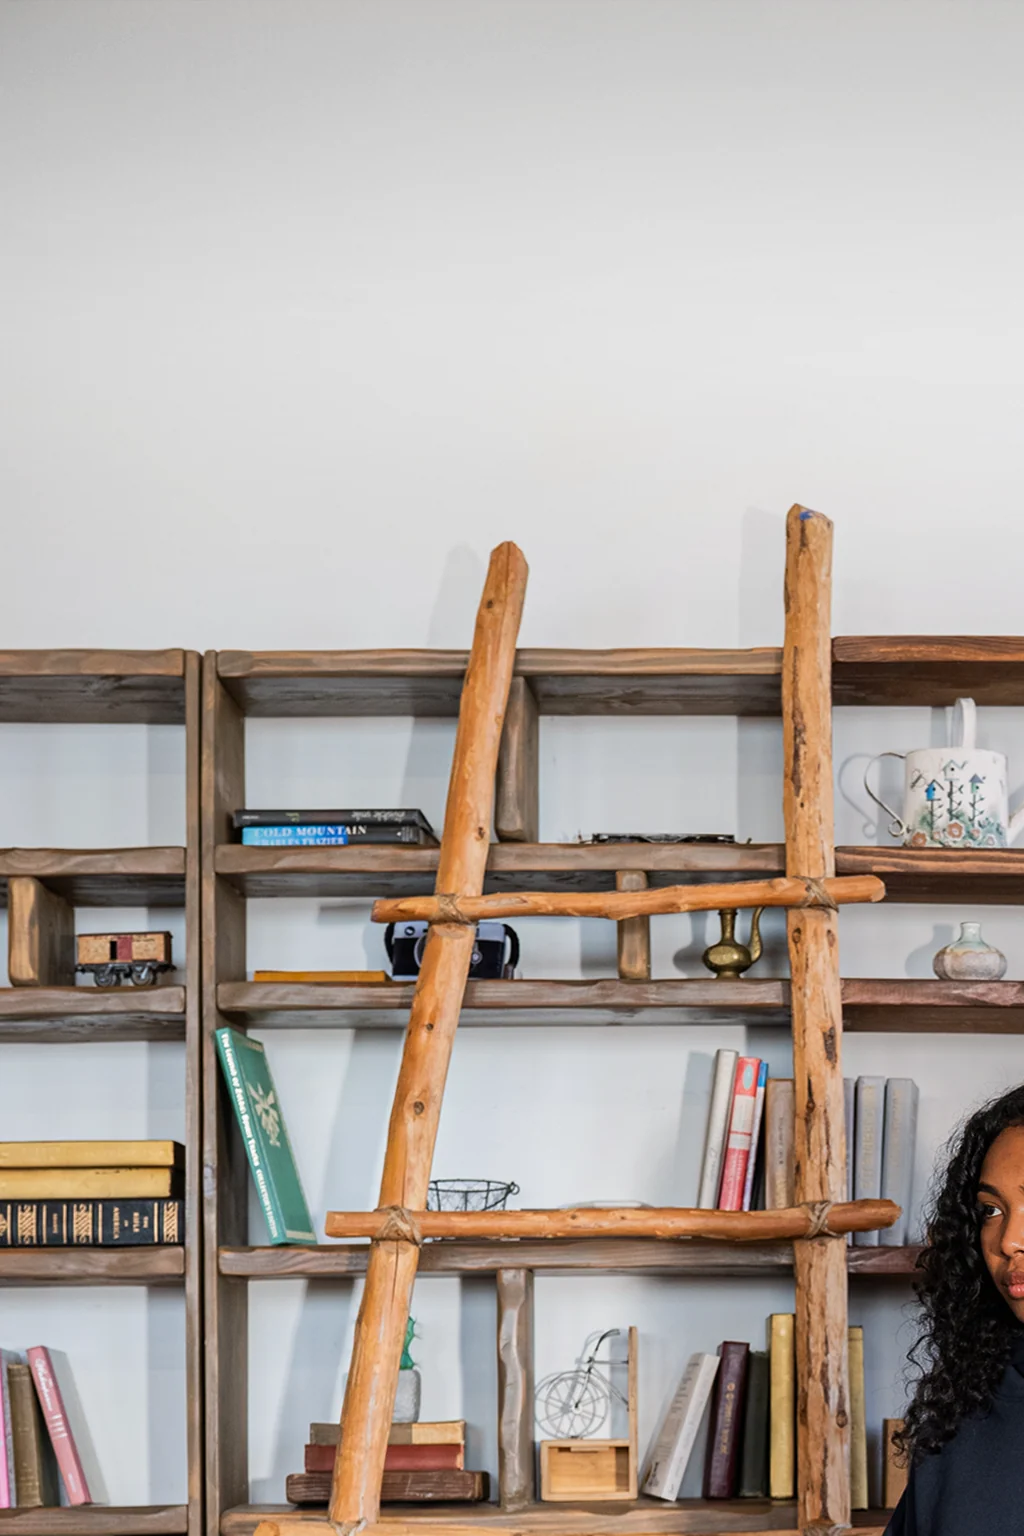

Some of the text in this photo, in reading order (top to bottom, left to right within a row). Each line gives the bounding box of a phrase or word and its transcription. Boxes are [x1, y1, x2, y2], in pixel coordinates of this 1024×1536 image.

[254, 825, 367, 837] COLD MOUNTAIN
[255, 837, 345, 846] CHARLES FRAZIER
[112, 1206, 120, 1240] AMERICA
[132, 1212, 140, 1233] RIFLE
